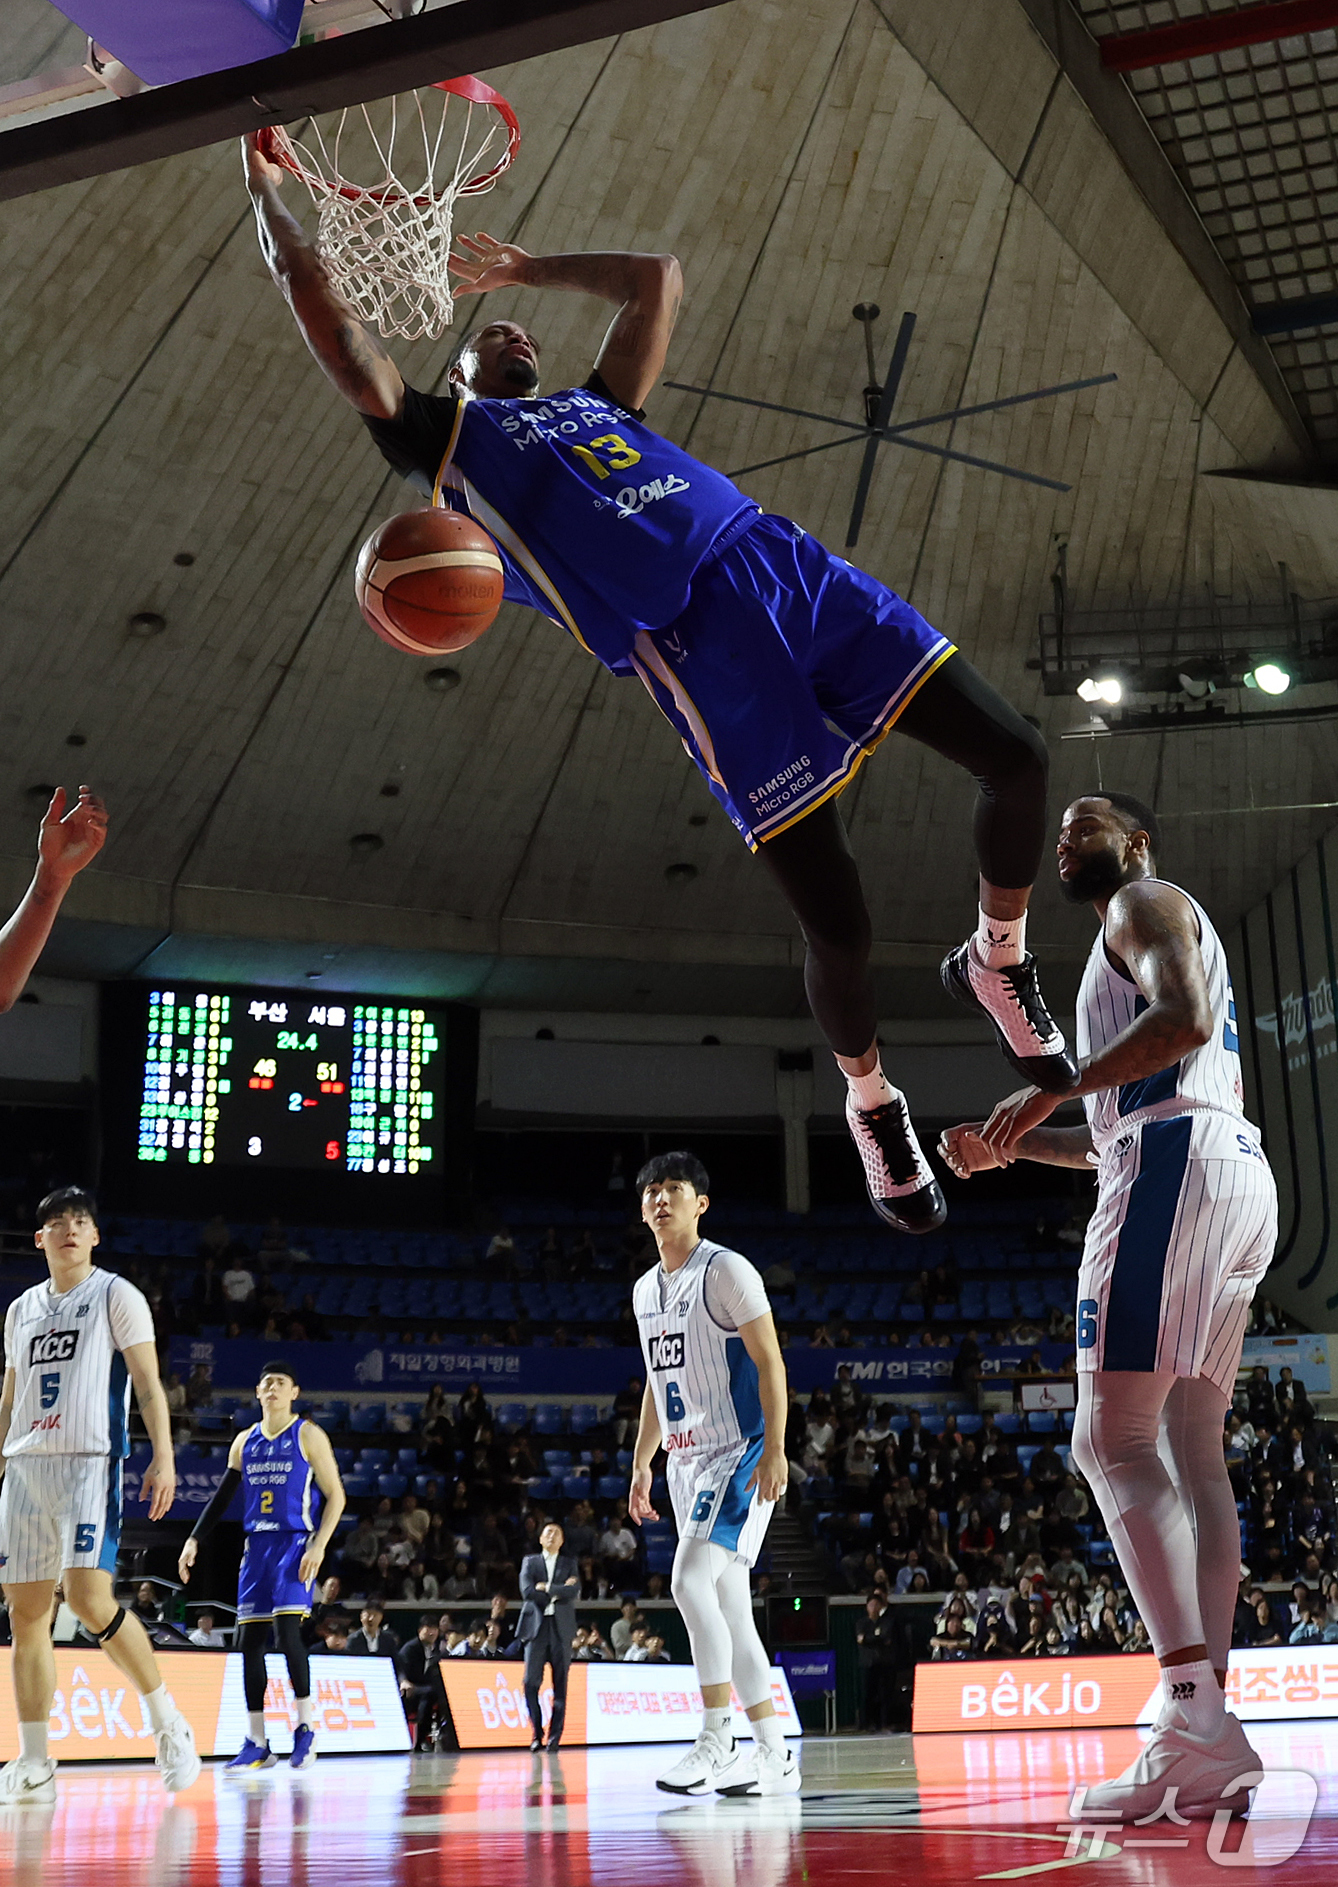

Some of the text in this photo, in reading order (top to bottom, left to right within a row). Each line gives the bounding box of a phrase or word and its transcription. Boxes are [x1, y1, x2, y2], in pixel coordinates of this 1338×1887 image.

[571, 434, 642, 480] 13
[748, 755, 812, 804] SAMSUNG
[755, 771, 815, 817] Micro RGB
[149, 991, 160, 1005] 3
[149, 1005, 160, 1019] 5
[247, 1000, 289, 1023] 부산
[353, 1005, 364, 1019] 2
[353, 1019, 364, 1033] 3
[411, 1023, 422, 1037] 0
[147, 1033, 158, 1047] 7
[276, 1031, 319, 1051] 24.4
[353, 1033, 363, 1046] 5
[411, 1036, 422, 1050] 2
[207, 1051, 218, 1065] 3
[352, 1046, 363, 1060] 7
[411, 1050, 421, 1064] 5
[253, 1058, 277, 1080] 46
[317, 1062, 338, 1082] 51
[410, 1064, 421, 1078] 0
[143, 1075, 159, 1089] 12
[350, 1074, 363, 1087] 11
[410, 1077, 420, 1091] 0
[288, 1092, 303, 1112] 2
[409, 1091, 422, 1105] 11
[140, 1103, 157, 1117] 23
[204, 1107, 220, 1121] 12
[409, 1105, 420, 1119] 4
[139, 1118, 155, 1132] 31
[204, 1121, 215, 1135] 2
[409, 1118, 420, 1132] 0
[247, 1136, 262, 1156] 3
[325, 1140, 341, 1160] 5
[345, 1157, 362, 1171] 77
[408, 1160, 419, 1174] 0
[1079, 1299, 1099, 1349] 6
[33, 1329, 74, 1364] KCC
[651, 1330, 683, 1369] KCC
[40, 1372, 60, 1410] 5
[666, 1381, 686, 1422] 6
[246, 1461, 294, 1475] SAMSUNG
[260, 1490, 274, 1514] 2
[690, 1491, 716, 1522] 6
[74, 1523, 97, 1553] 5
